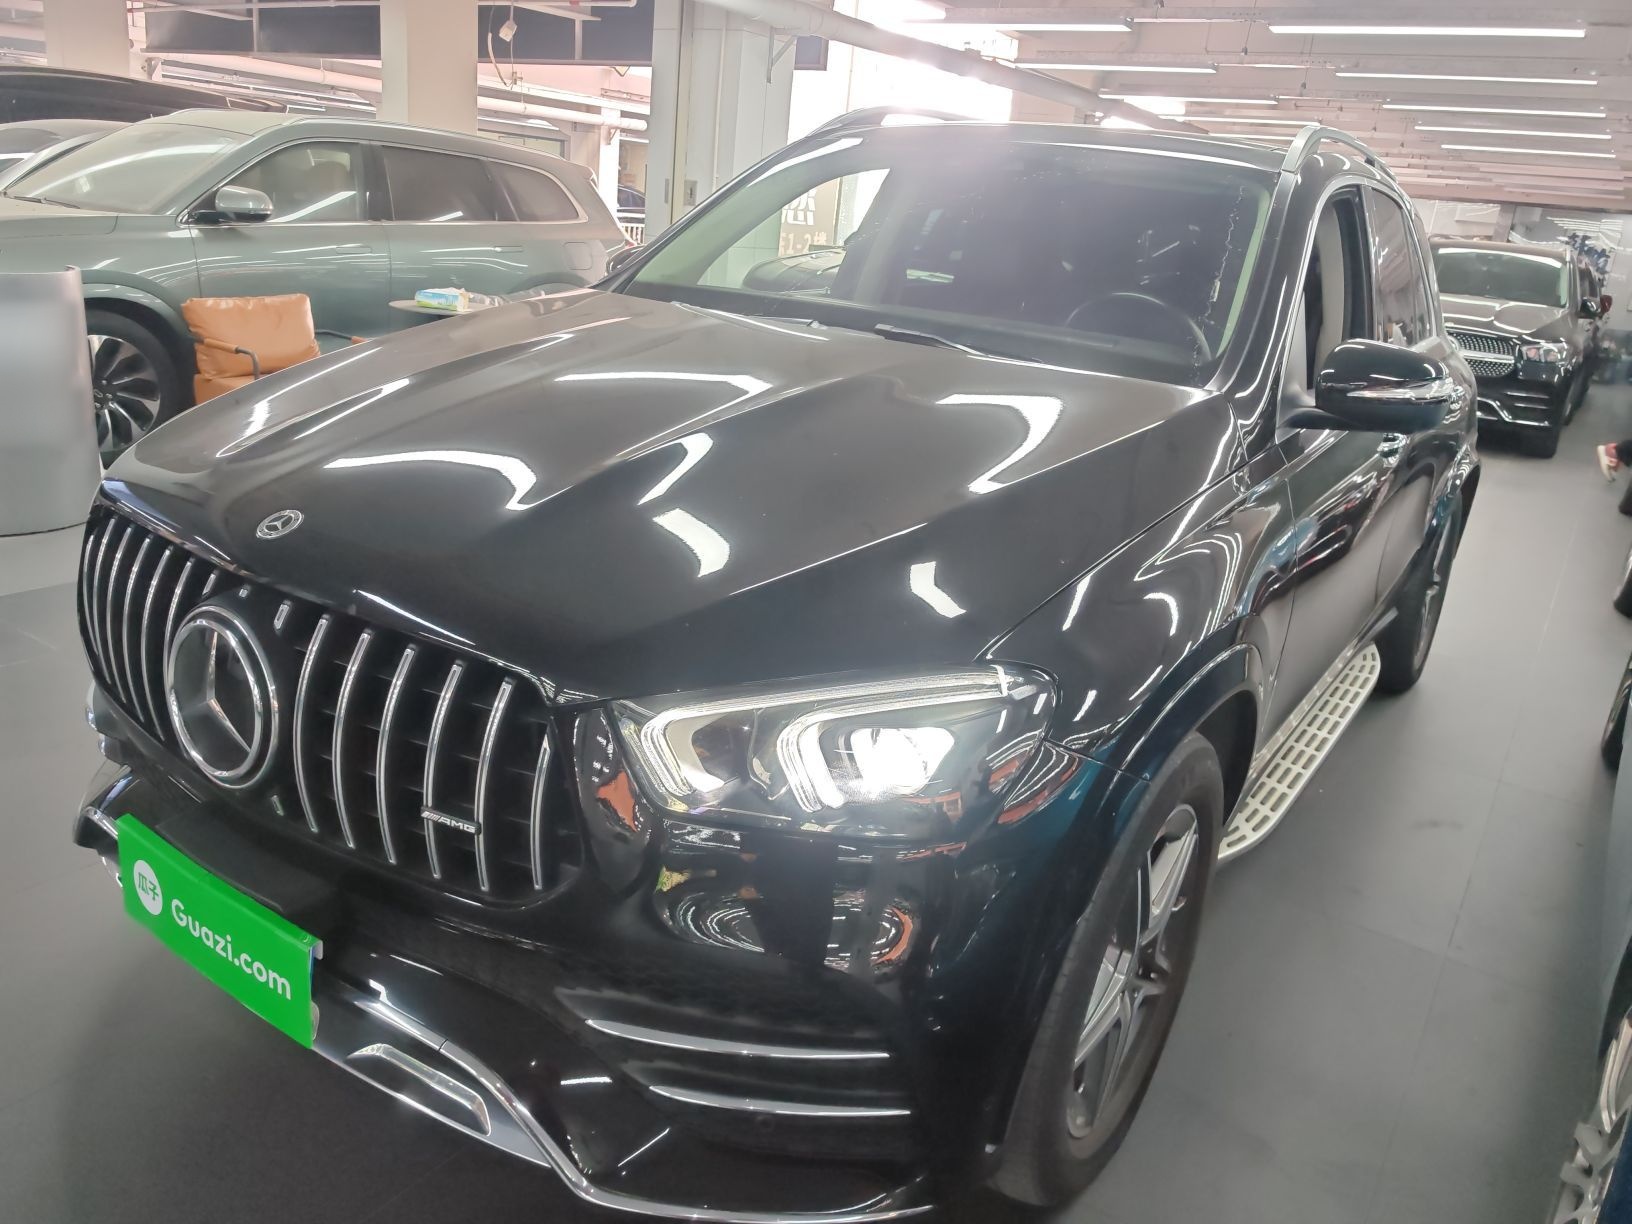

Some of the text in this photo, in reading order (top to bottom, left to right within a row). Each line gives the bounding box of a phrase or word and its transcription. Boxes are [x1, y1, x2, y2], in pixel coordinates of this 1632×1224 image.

[438, 816, 477, 834] AMG
[138, 871, 160, 902] 瓜子
[171, 898, 292, 1000] Guazi.com
